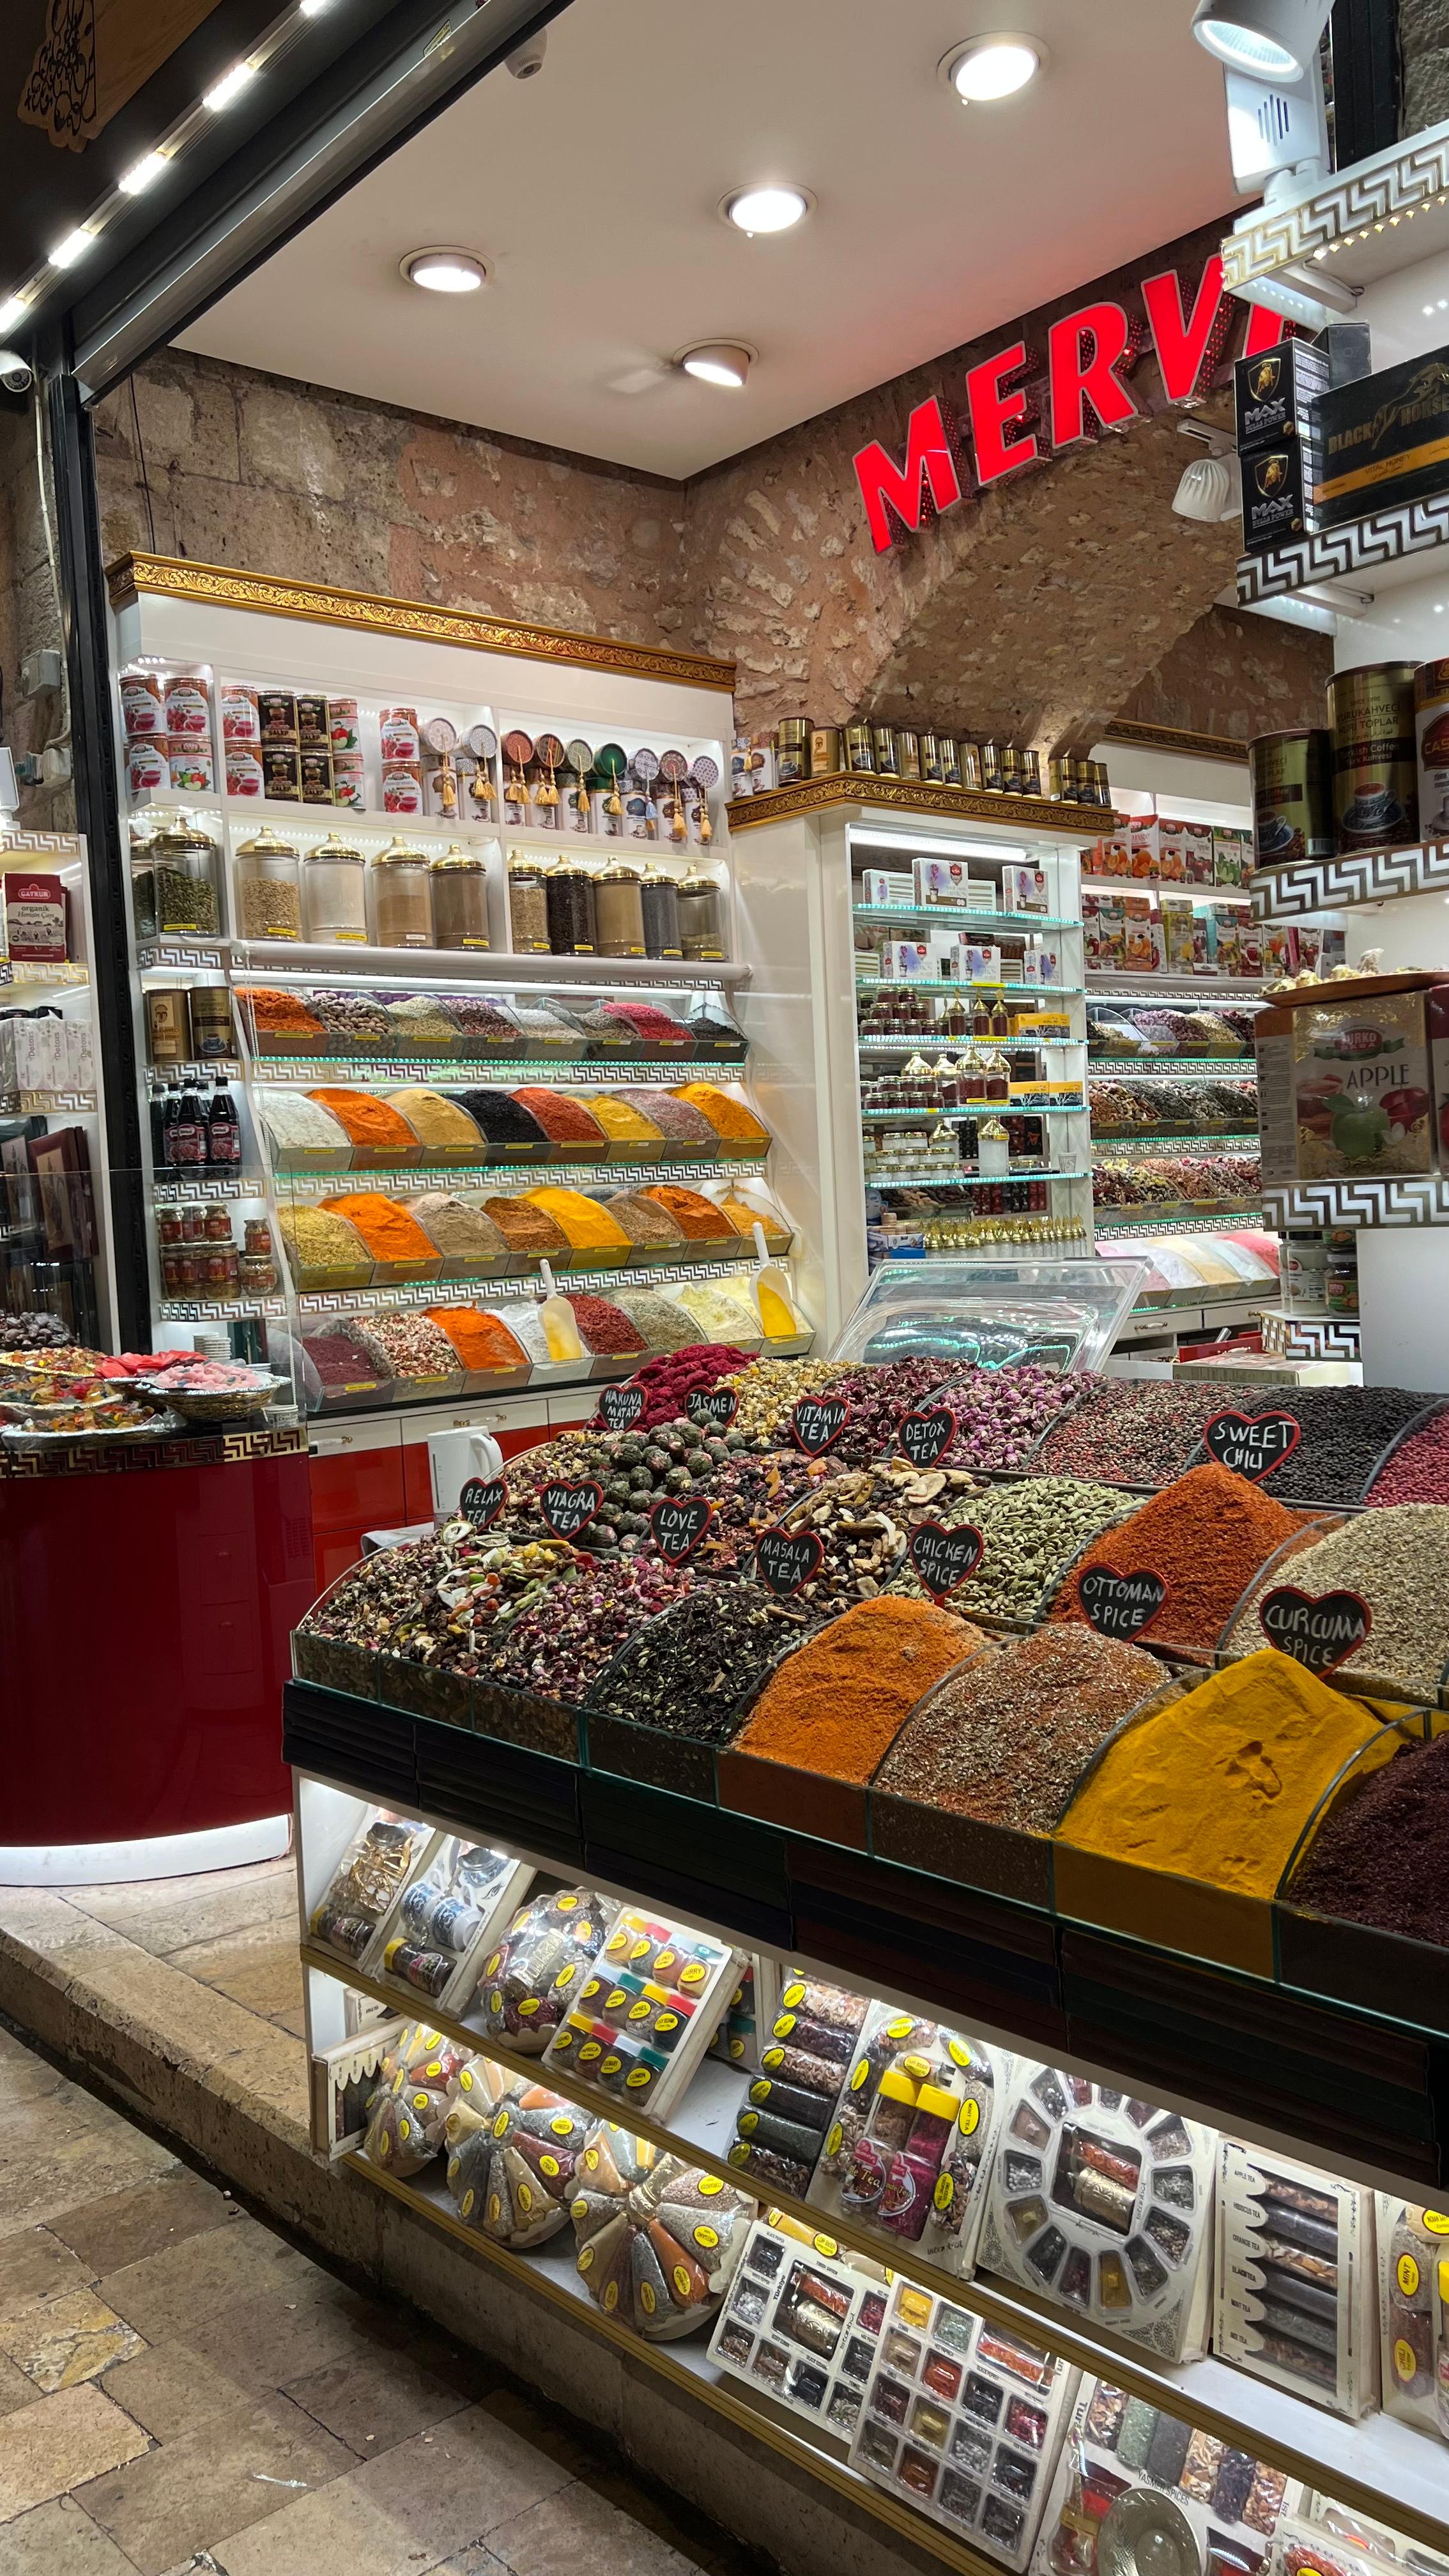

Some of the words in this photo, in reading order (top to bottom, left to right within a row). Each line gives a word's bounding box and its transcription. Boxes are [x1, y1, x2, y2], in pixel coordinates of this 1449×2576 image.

[1245, 397, 1286, 425] MAX
[1328, 421, 1374, 455] BLACK
[1386, 453, 1411, 466] HONEY
[1251, 494, 1294, 521] MAX
[1360, 716, 1399, 728] TOPLAR
[1347, 1064, 1410, 1089] APPLE
[605, 1390, 642, 1407] HAKUNA
[687, 1393, 736, 1414] JASMEN
[606, 1404, 642, 1419] MATATA
[796, 1404, 847, 1423] VITAMIN
[608, 1417, 625, 1430] TEA
[800, 1423, 830, 1442] TEA
[905, 1423, 946, 1442] DETOX
[1215, 1421, 1295, 1449] SWEET
[910, 1443, 939, 1461] TEA
[464, 1488, 504, 1505] RELAX
[547, 1490, 596, 1512] VIAGRA
[466, 1509, 487, 1526] TEA
[550, 1510, 581, 1529] TEA
[659, 1508, 698, 1529] LOVE
[661, 1532, 690, 1552] TEA
[761, 1537, 810, 1563] MASALA
[913, 1535, 977, 1565] CHICKEN
[767, 1561, 802, 1583] TEA
[919, 1558, 961, 1586] SPICE
[1083, 1576, 1165, 1602] OTTOMAN
[1089, 1604, 1146, 1627] SPICE
[1264, 1605, 1366, 1641] CURCUMA
[1282, 1636, 1334, 1664] SPICE
[860, 2166, 881, 2188] Tea
[1252, 2209, 1261, 2219] TEA
[1232, 2234, 1251, 2248] ORANGE
[1251, 2241, 1260, 2251] TEA
[1232, 2266, 1246, 2278] BLACK
[1246, 2273, 1257, 2283] TEA
[1402, 2262, 1411, 2287] MINT
[772, 2274, 786, 2301] Türkiye
[1240, 2303, 1251, 2314] TEA
[1239, 2335, 1248, 2345] TEA
[1167, 2487, 1191, 2506] SPICES
